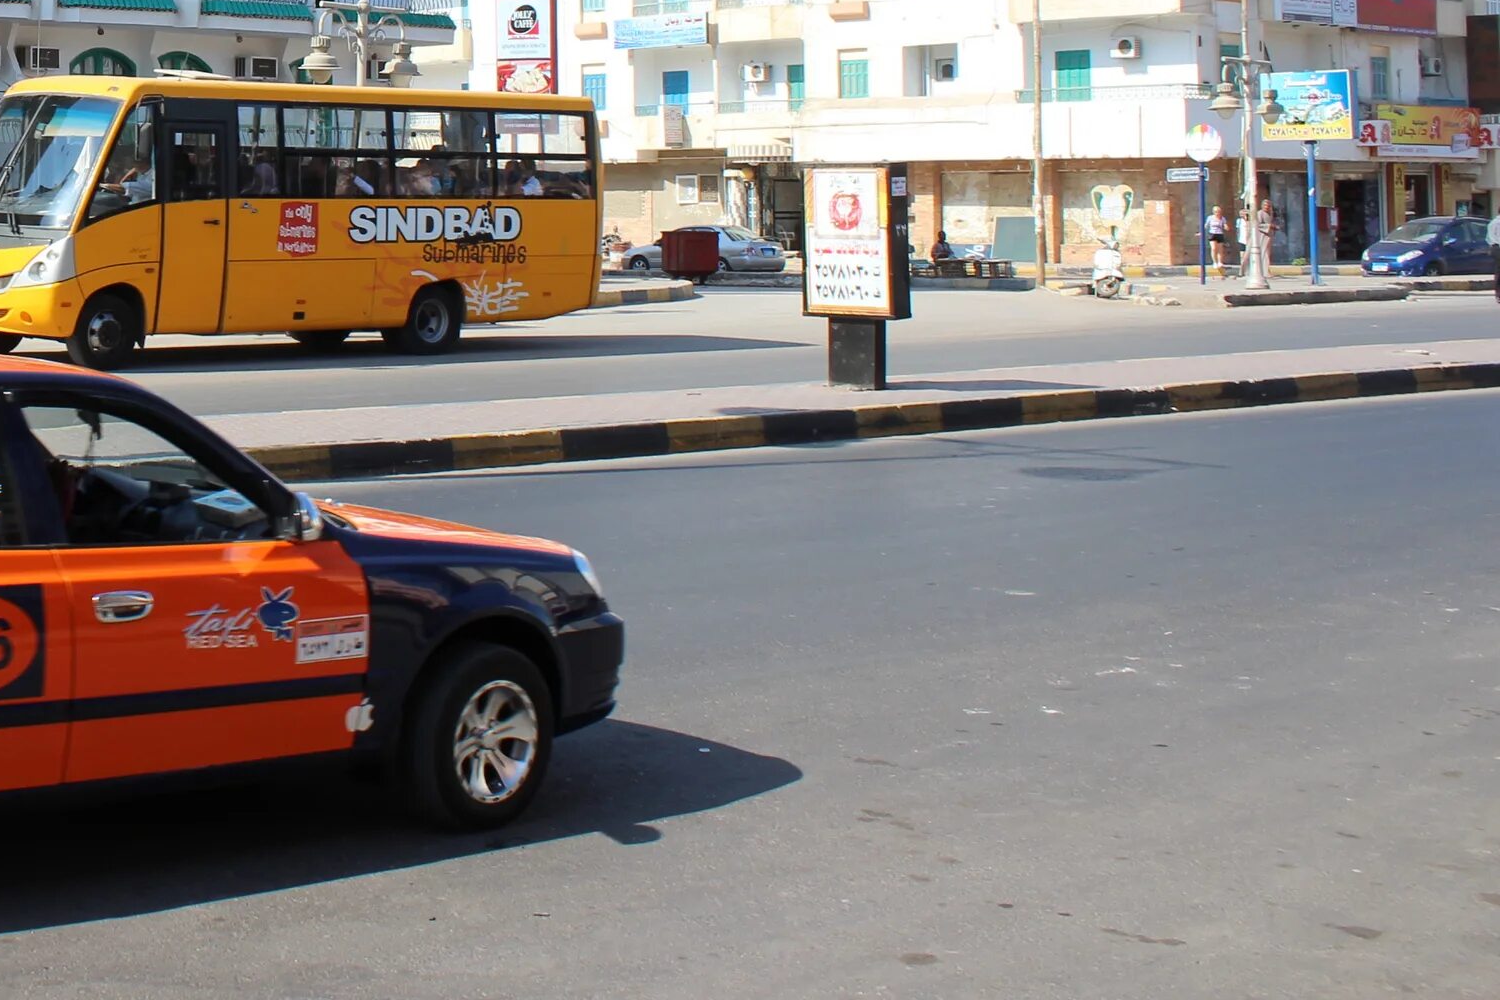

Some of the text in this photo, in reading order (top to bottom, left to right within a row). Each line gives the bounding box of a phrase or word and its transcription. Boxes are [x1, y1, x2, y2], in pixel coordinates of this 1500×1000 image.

[295, 204, 313, 223] only
[349, 206, 521, 243] SINDBAD
[423, 242, 527, 264] Submarines
[815, 263, 869, 280] ٢٥٧٨١٠٣٠
[815, 284, 869, 300] ٢٥٧٨١٠٦٠
[187, 634, 259, 648] RED SEA
